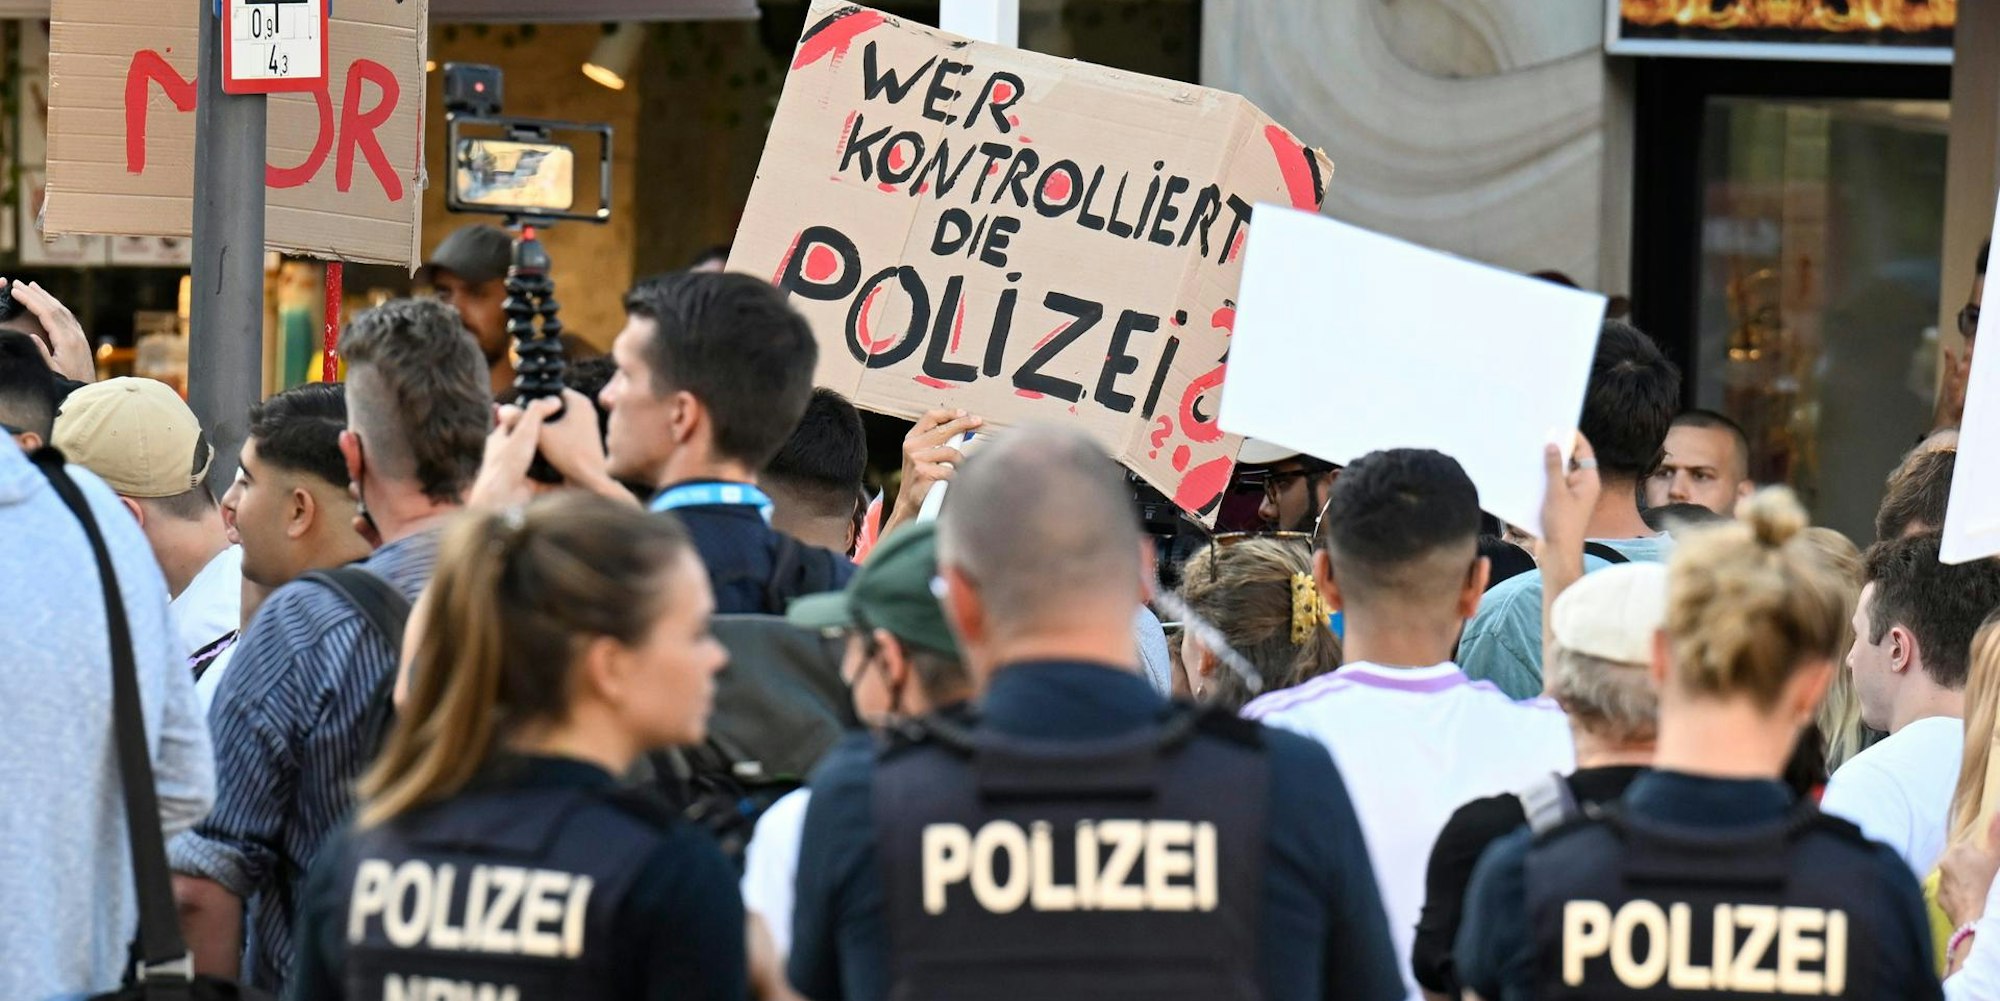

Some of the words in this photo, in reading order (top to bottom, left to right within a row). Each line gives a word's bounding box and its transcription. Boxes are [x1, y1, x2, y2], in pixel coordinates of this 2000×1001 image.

[863, 40, 1025, 134] WER
[930, 208, 1021, 268] DIE
[347, 858, 594, 959] POLIZEI
[921, 818, 1219, 915] POLIZEI
[1562, 899, 1848, 997] POLIZEI
